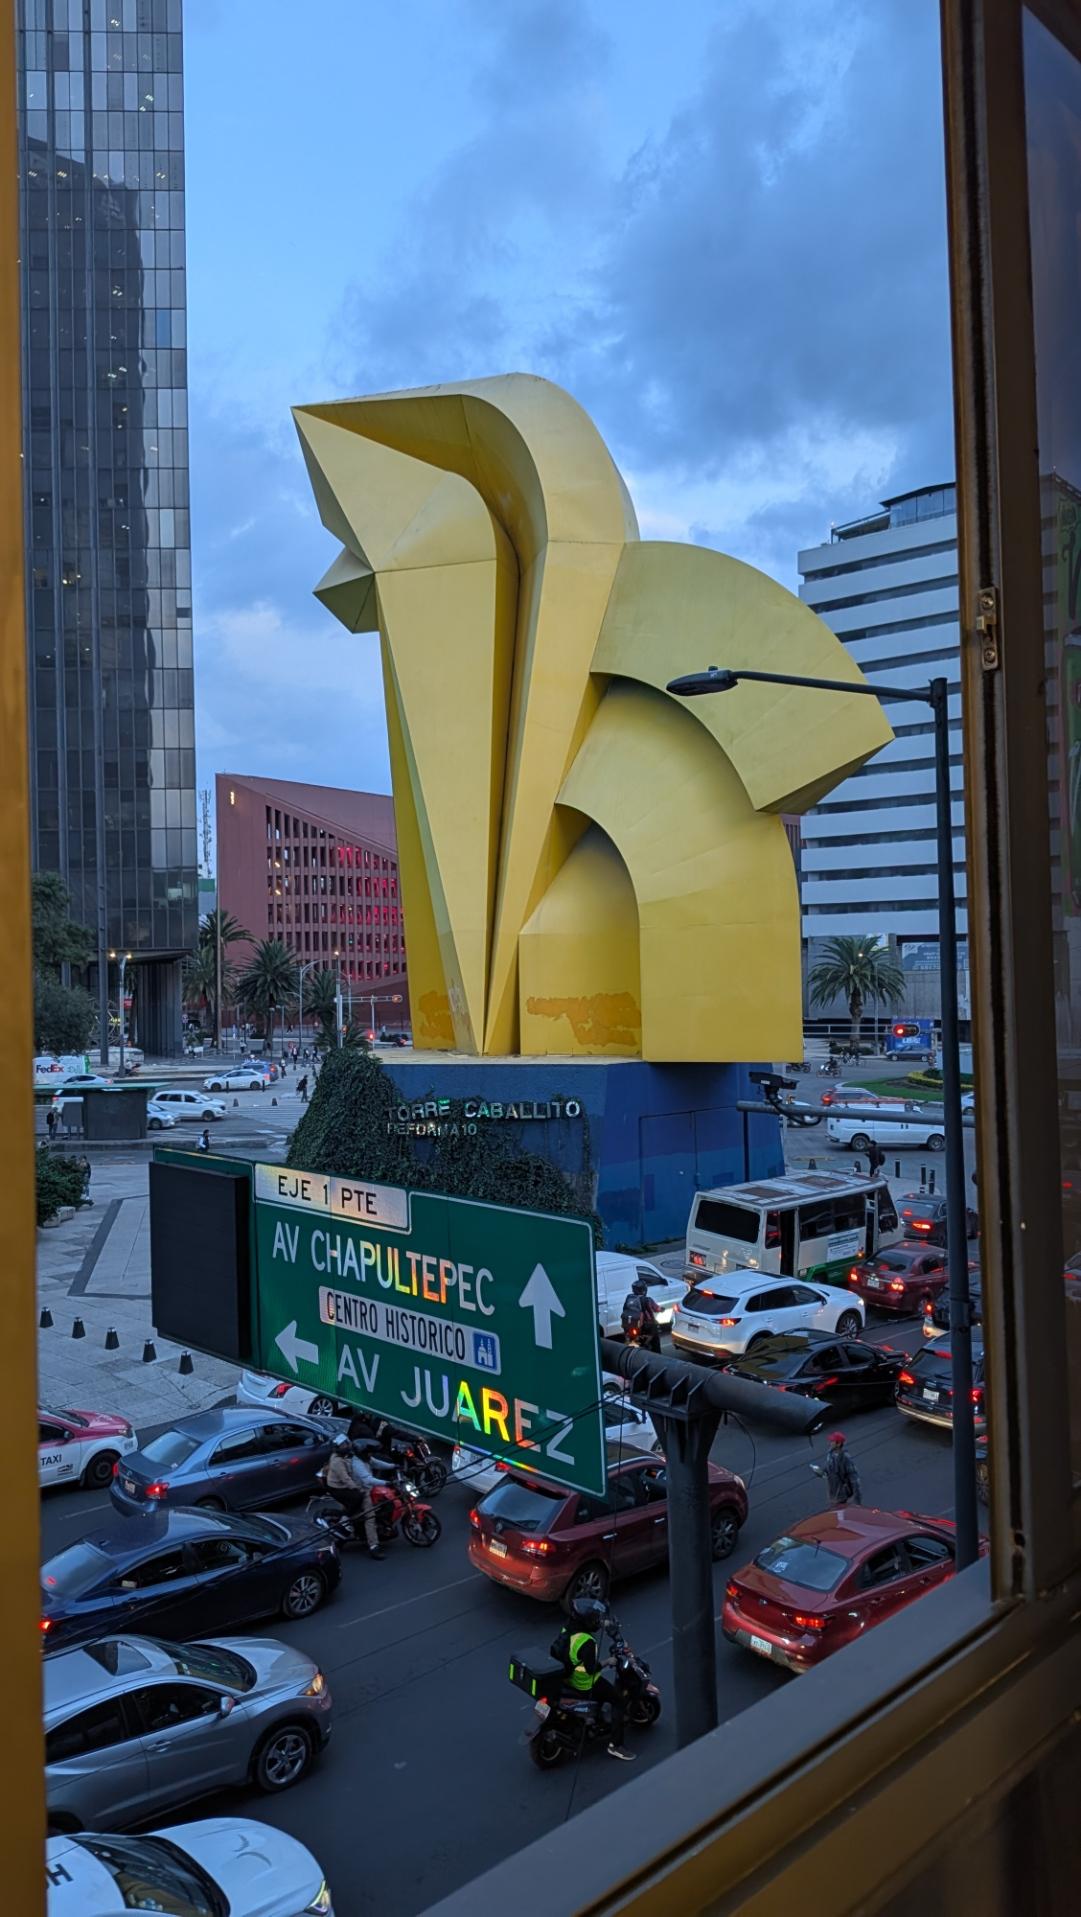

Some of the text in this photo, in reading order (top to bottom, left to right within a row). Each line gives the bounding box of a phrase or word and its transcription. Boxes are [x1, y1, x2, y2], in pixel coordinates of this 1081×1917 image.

[36, 1064, 64, 1073] FedEx
[385, 1099, 580, 1121] TORRE CABALLITO
[462, 1123, 478, 1136] 10
[278, 1174, 378, 1215] EJE 1 PTE
[272, 1221, 496, 1316] AV CHAPULTEPEC
[326, 1291, 466, 1361] CENTRO HISTORICO
[337, 1344, 576, 1465] AV JUAREZ
[40, 1454, 62, 1466] TAXI
